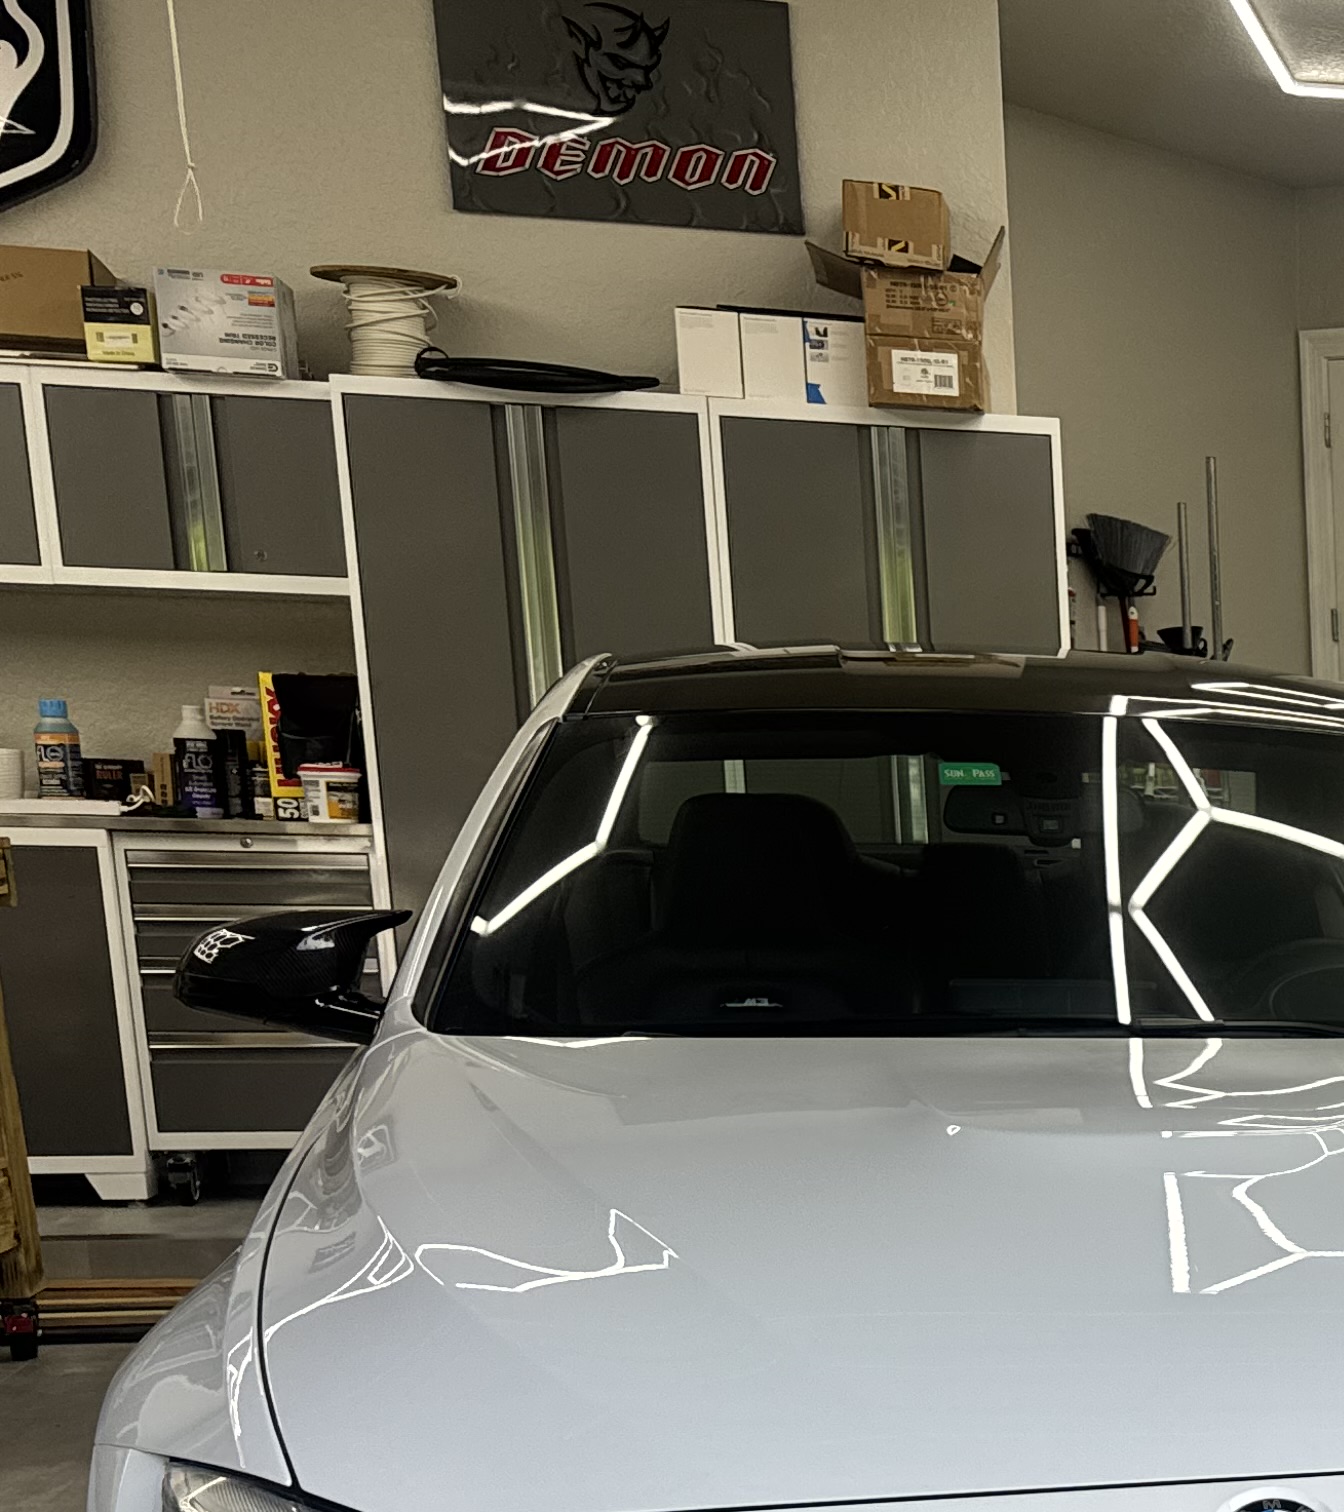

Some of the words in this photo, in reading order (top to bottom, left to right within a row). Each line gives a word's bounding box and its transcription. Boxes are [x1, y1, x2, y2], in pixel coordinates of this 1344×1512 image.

[476, 127, 777, 195] DEMON
[208, 701, 241, 714] HDX
[972, 768, 996, 778] PASS
[276, 797, 300, 820] 50
